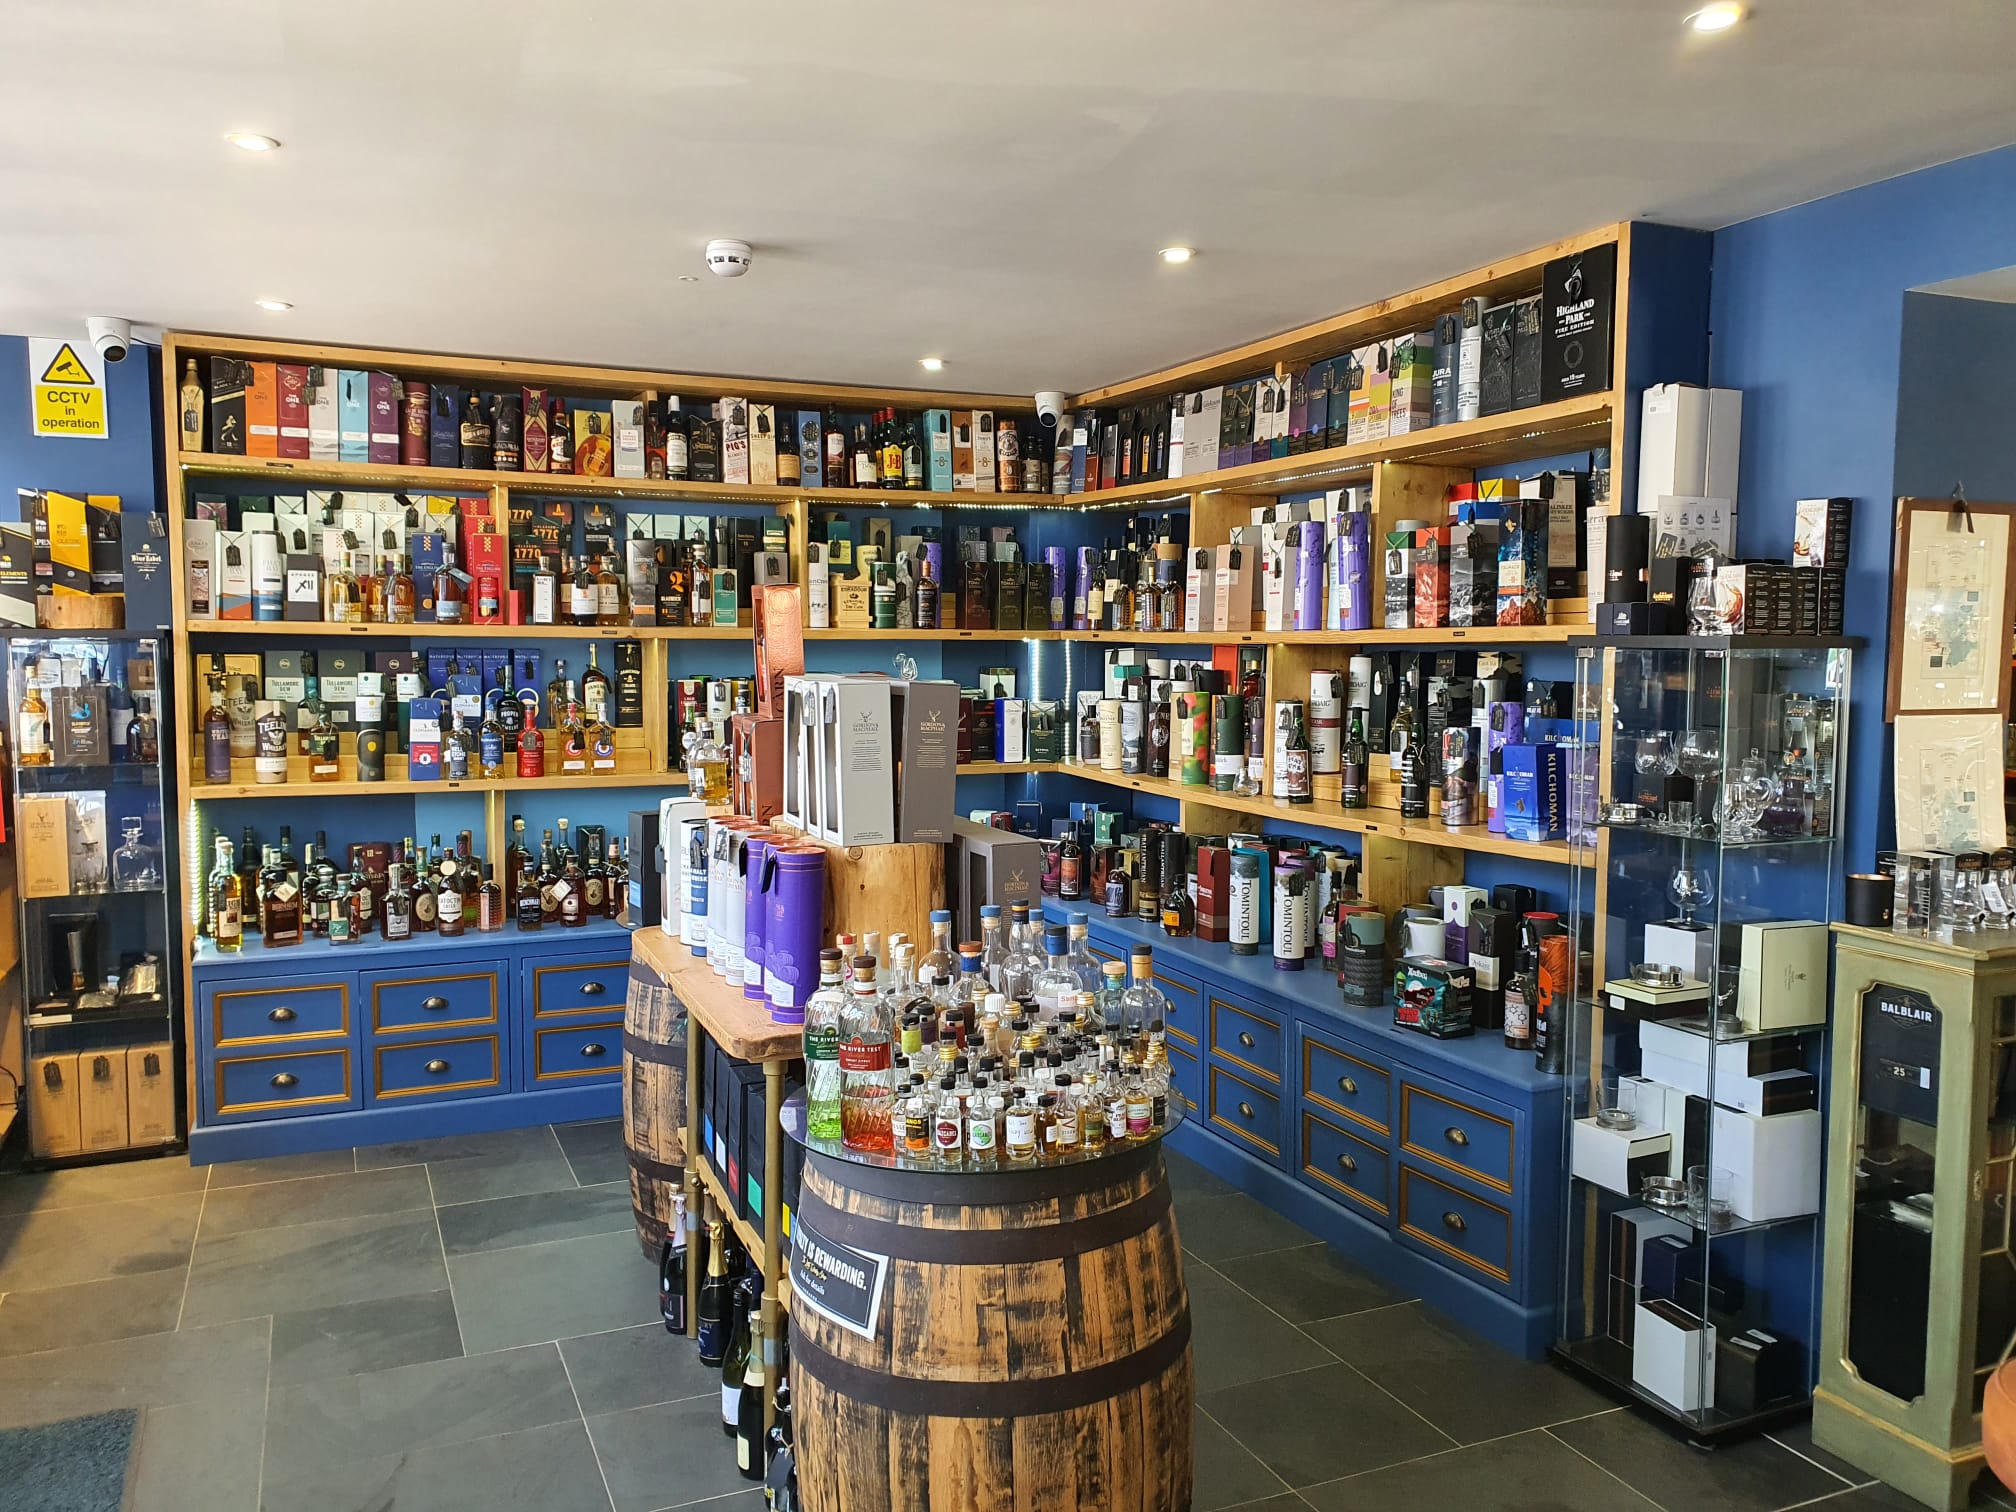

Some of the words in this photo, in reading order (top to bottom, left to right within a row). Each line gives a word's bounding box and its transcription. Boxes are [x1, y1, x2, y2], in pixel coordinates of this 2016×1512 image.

[1556, 299, 1594, 317] HIGHLAND
[1565, 312, 1584, 325] PARK
[1432, 368, 1451, 378] JURA
[47, 391, 90, 404] CCTV
[1392, 388, 1404, 397] KING
[286, 396, 300, 404] ONE
[65, 406, 76, 416] in
[1391, 408, 1406, 419] TREES
[42, 418, 99, 429] operation
[726, 441, 746, 451] PIG'S
[938, 456, 945, 467] 8
[982, 457, 988, 467] 8
[533, 528, 559, 540] 1770
[514, 548, 542, 559] 1770
[258, 722, 287, 734] TEELIN
[1547, 753, 1557, 832] KILCHOMAN
[1241, 880, 1252, 940] TOMINTOUL
[1283, 893, 1293, 955] TOMINTOUL
[1881, 1002, 1932, 1022] BALBLAIR
[1894, 1067, 1905, 1076] 25
[814, 1246, 866, 1290] REWARDING.
